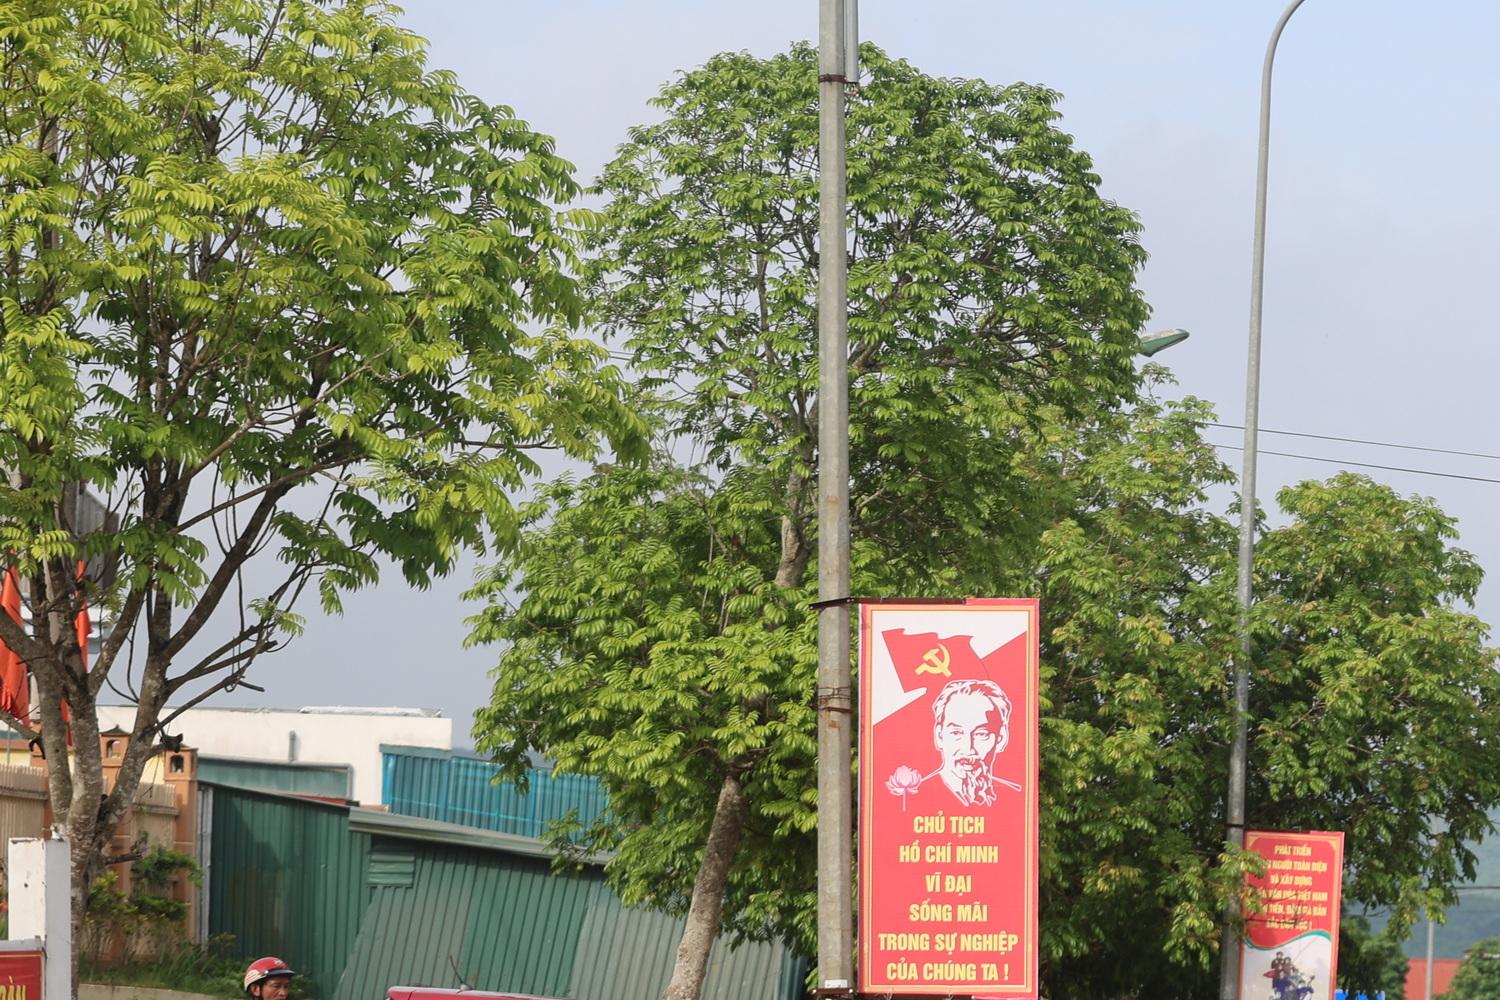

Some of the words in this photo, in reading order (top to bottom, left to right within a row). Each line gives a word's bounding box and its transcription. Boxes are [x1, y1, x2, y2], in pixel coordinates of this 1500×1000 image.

[913, 810, 945, 833] CHỦ
[950, 816, 985, 837] TỊCH
[925, 842, 952, 863] CHÍ
[956, 845, 999, 863] MINH
[925, 871, 941, 892] VĨ
[944, 875, 972, 896] ĐẠI
[909, 898, 953, 922] SỐNG
[957, 901, 988, 922] MÃI
[878, 933, 930, 951] TRONG
[934, 932, 958, 955] SỰ
[960, 930, 1019, 955] NGHIỆP
[886, 957, 918, 980] CỦA
[922, 960, 977, 981] CHÚNG
[980, 963, 999, 981] TA
[1004, 964, 1009, 980] !
